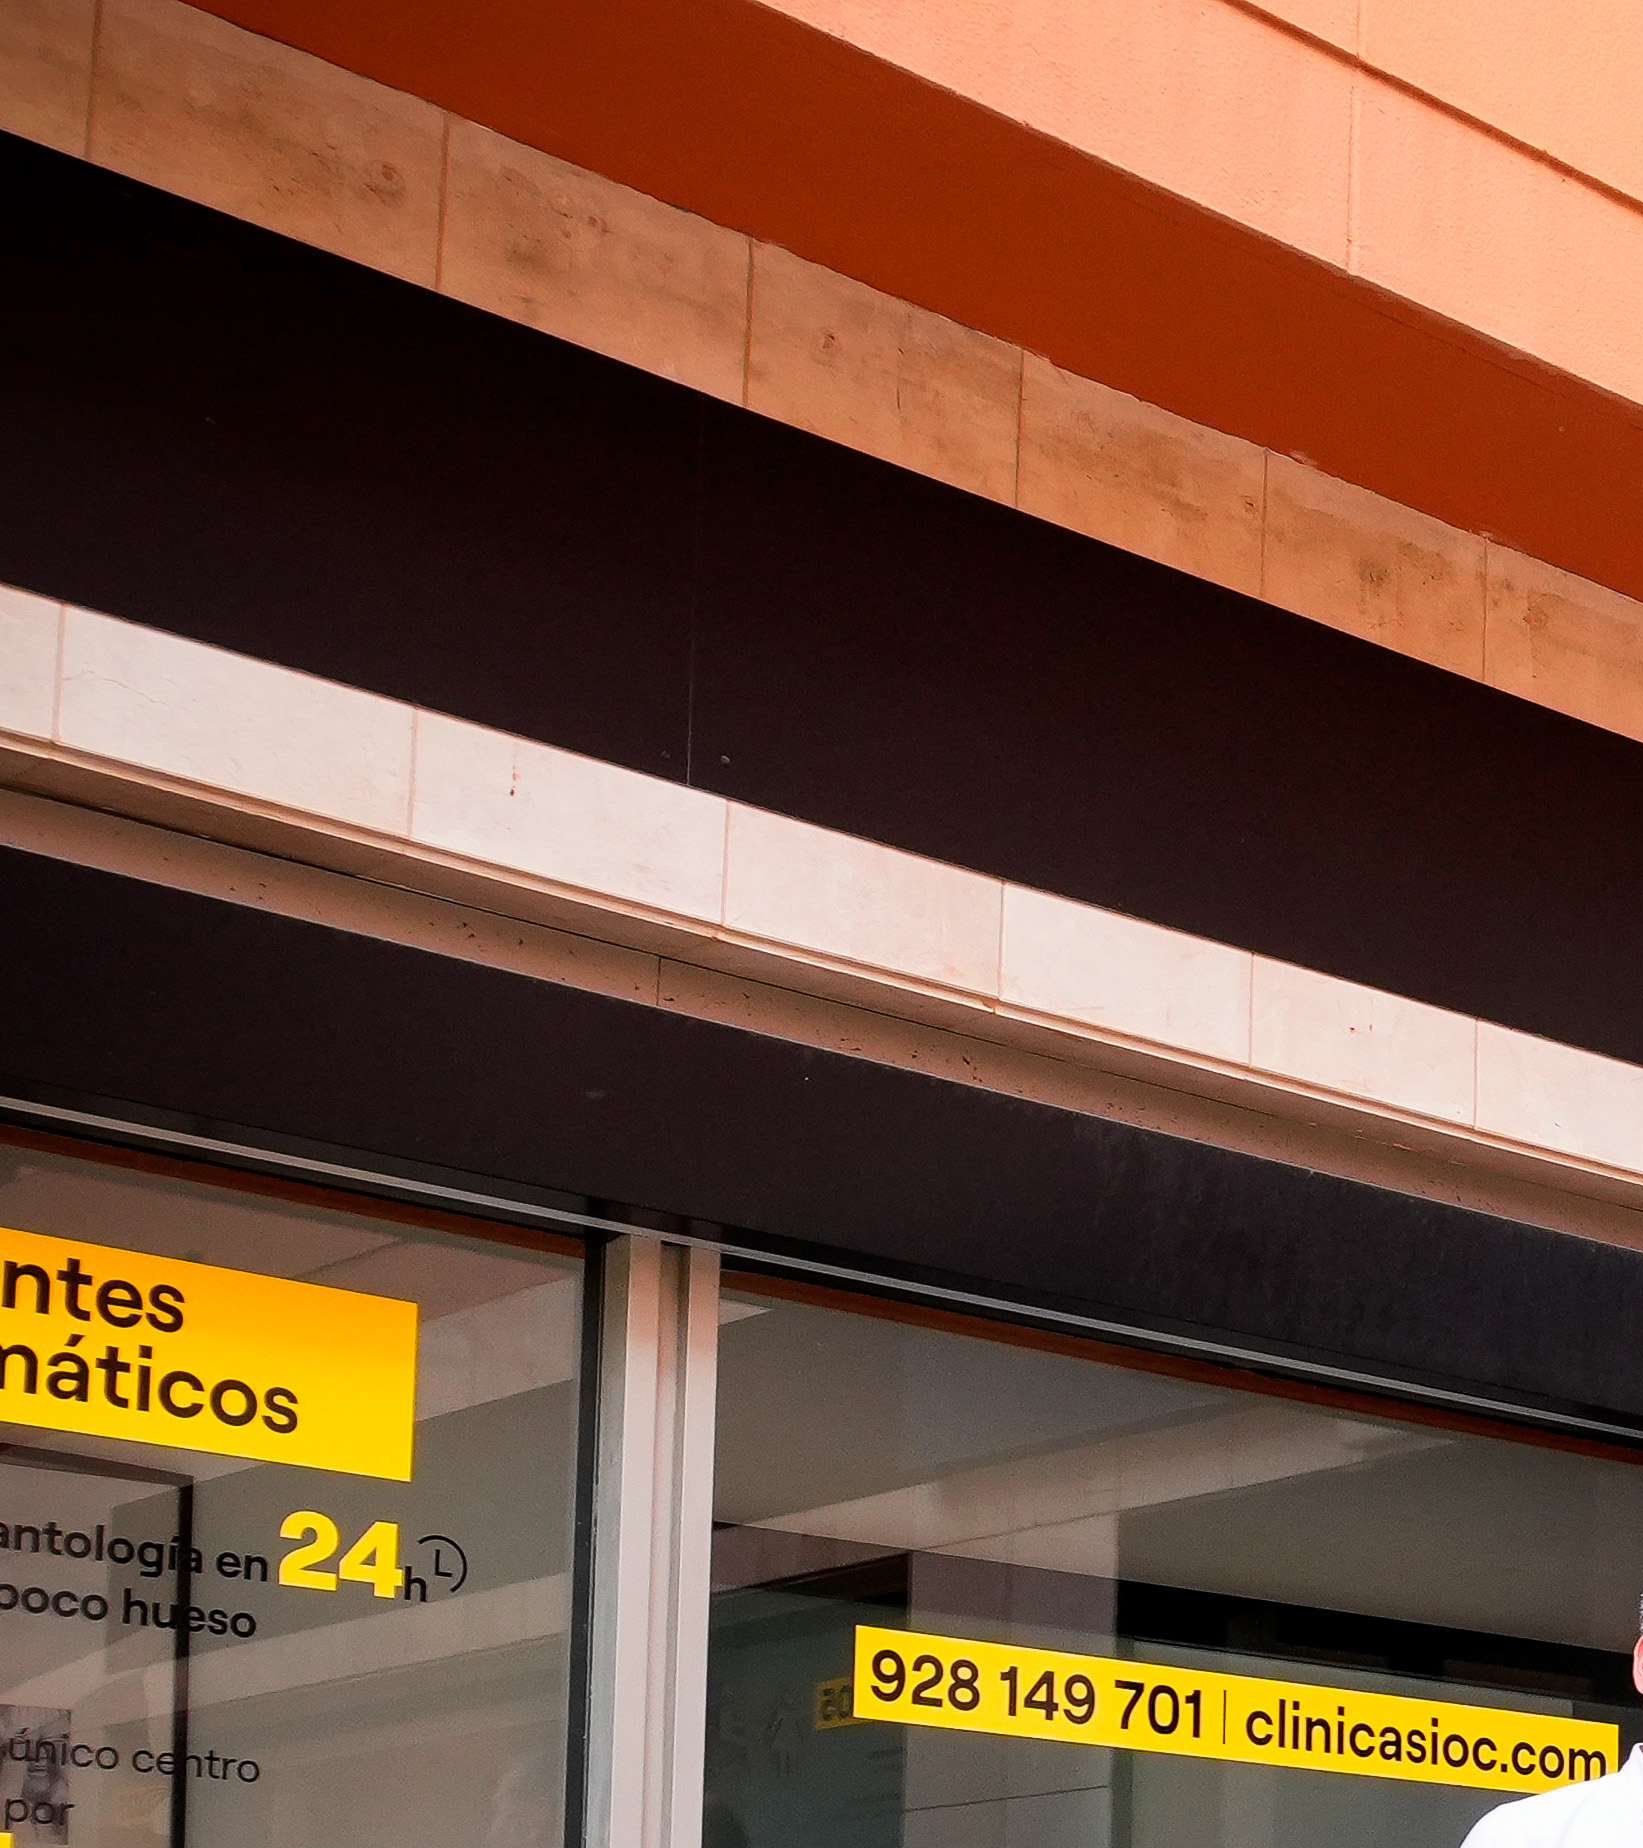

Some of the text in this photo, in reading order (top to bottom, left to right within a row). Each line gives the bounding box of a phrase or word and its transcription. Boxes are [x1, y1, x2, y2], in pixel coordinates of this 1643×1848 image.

[1, 1256, 186, 1334] ntes
[215, 1550, 269, 1583] en
[121, 1588, 257, 1639] hueso
[870, 1649, 981, 1712] 928
[999, 1666, 1095, 1725] 149
[1114, 1680, 1203, 1739] 701
[1245, 1698, 1608, 1782] clinicasioc.com
[132, 1749, 261, 1784] centro
[4, 1797, 75, 1831] por
